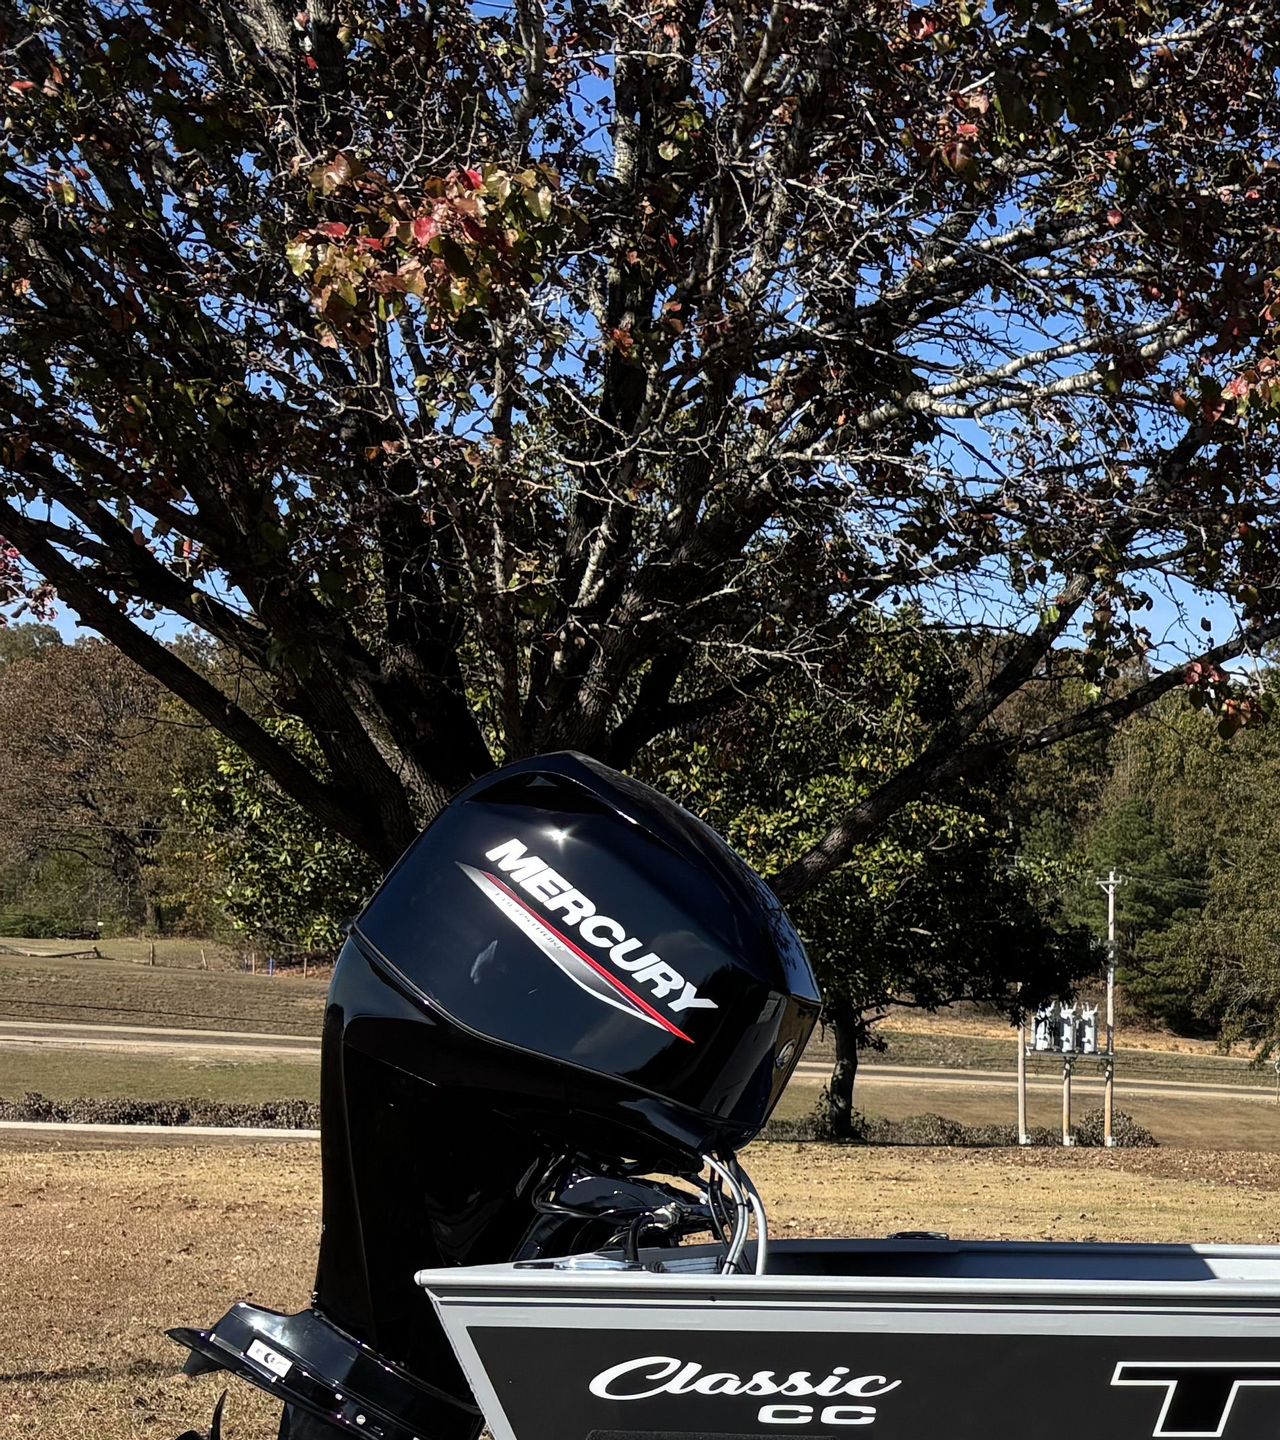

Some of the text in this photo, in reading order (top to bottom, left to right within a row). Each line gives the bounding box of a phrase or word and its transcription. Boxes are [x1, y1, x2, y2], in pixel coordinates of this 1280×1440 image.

[485, 838, 719, 1013] MERCURY
[589, 1355, 902, 1401] Classic
[757, 1404, 877, 1425] CC
